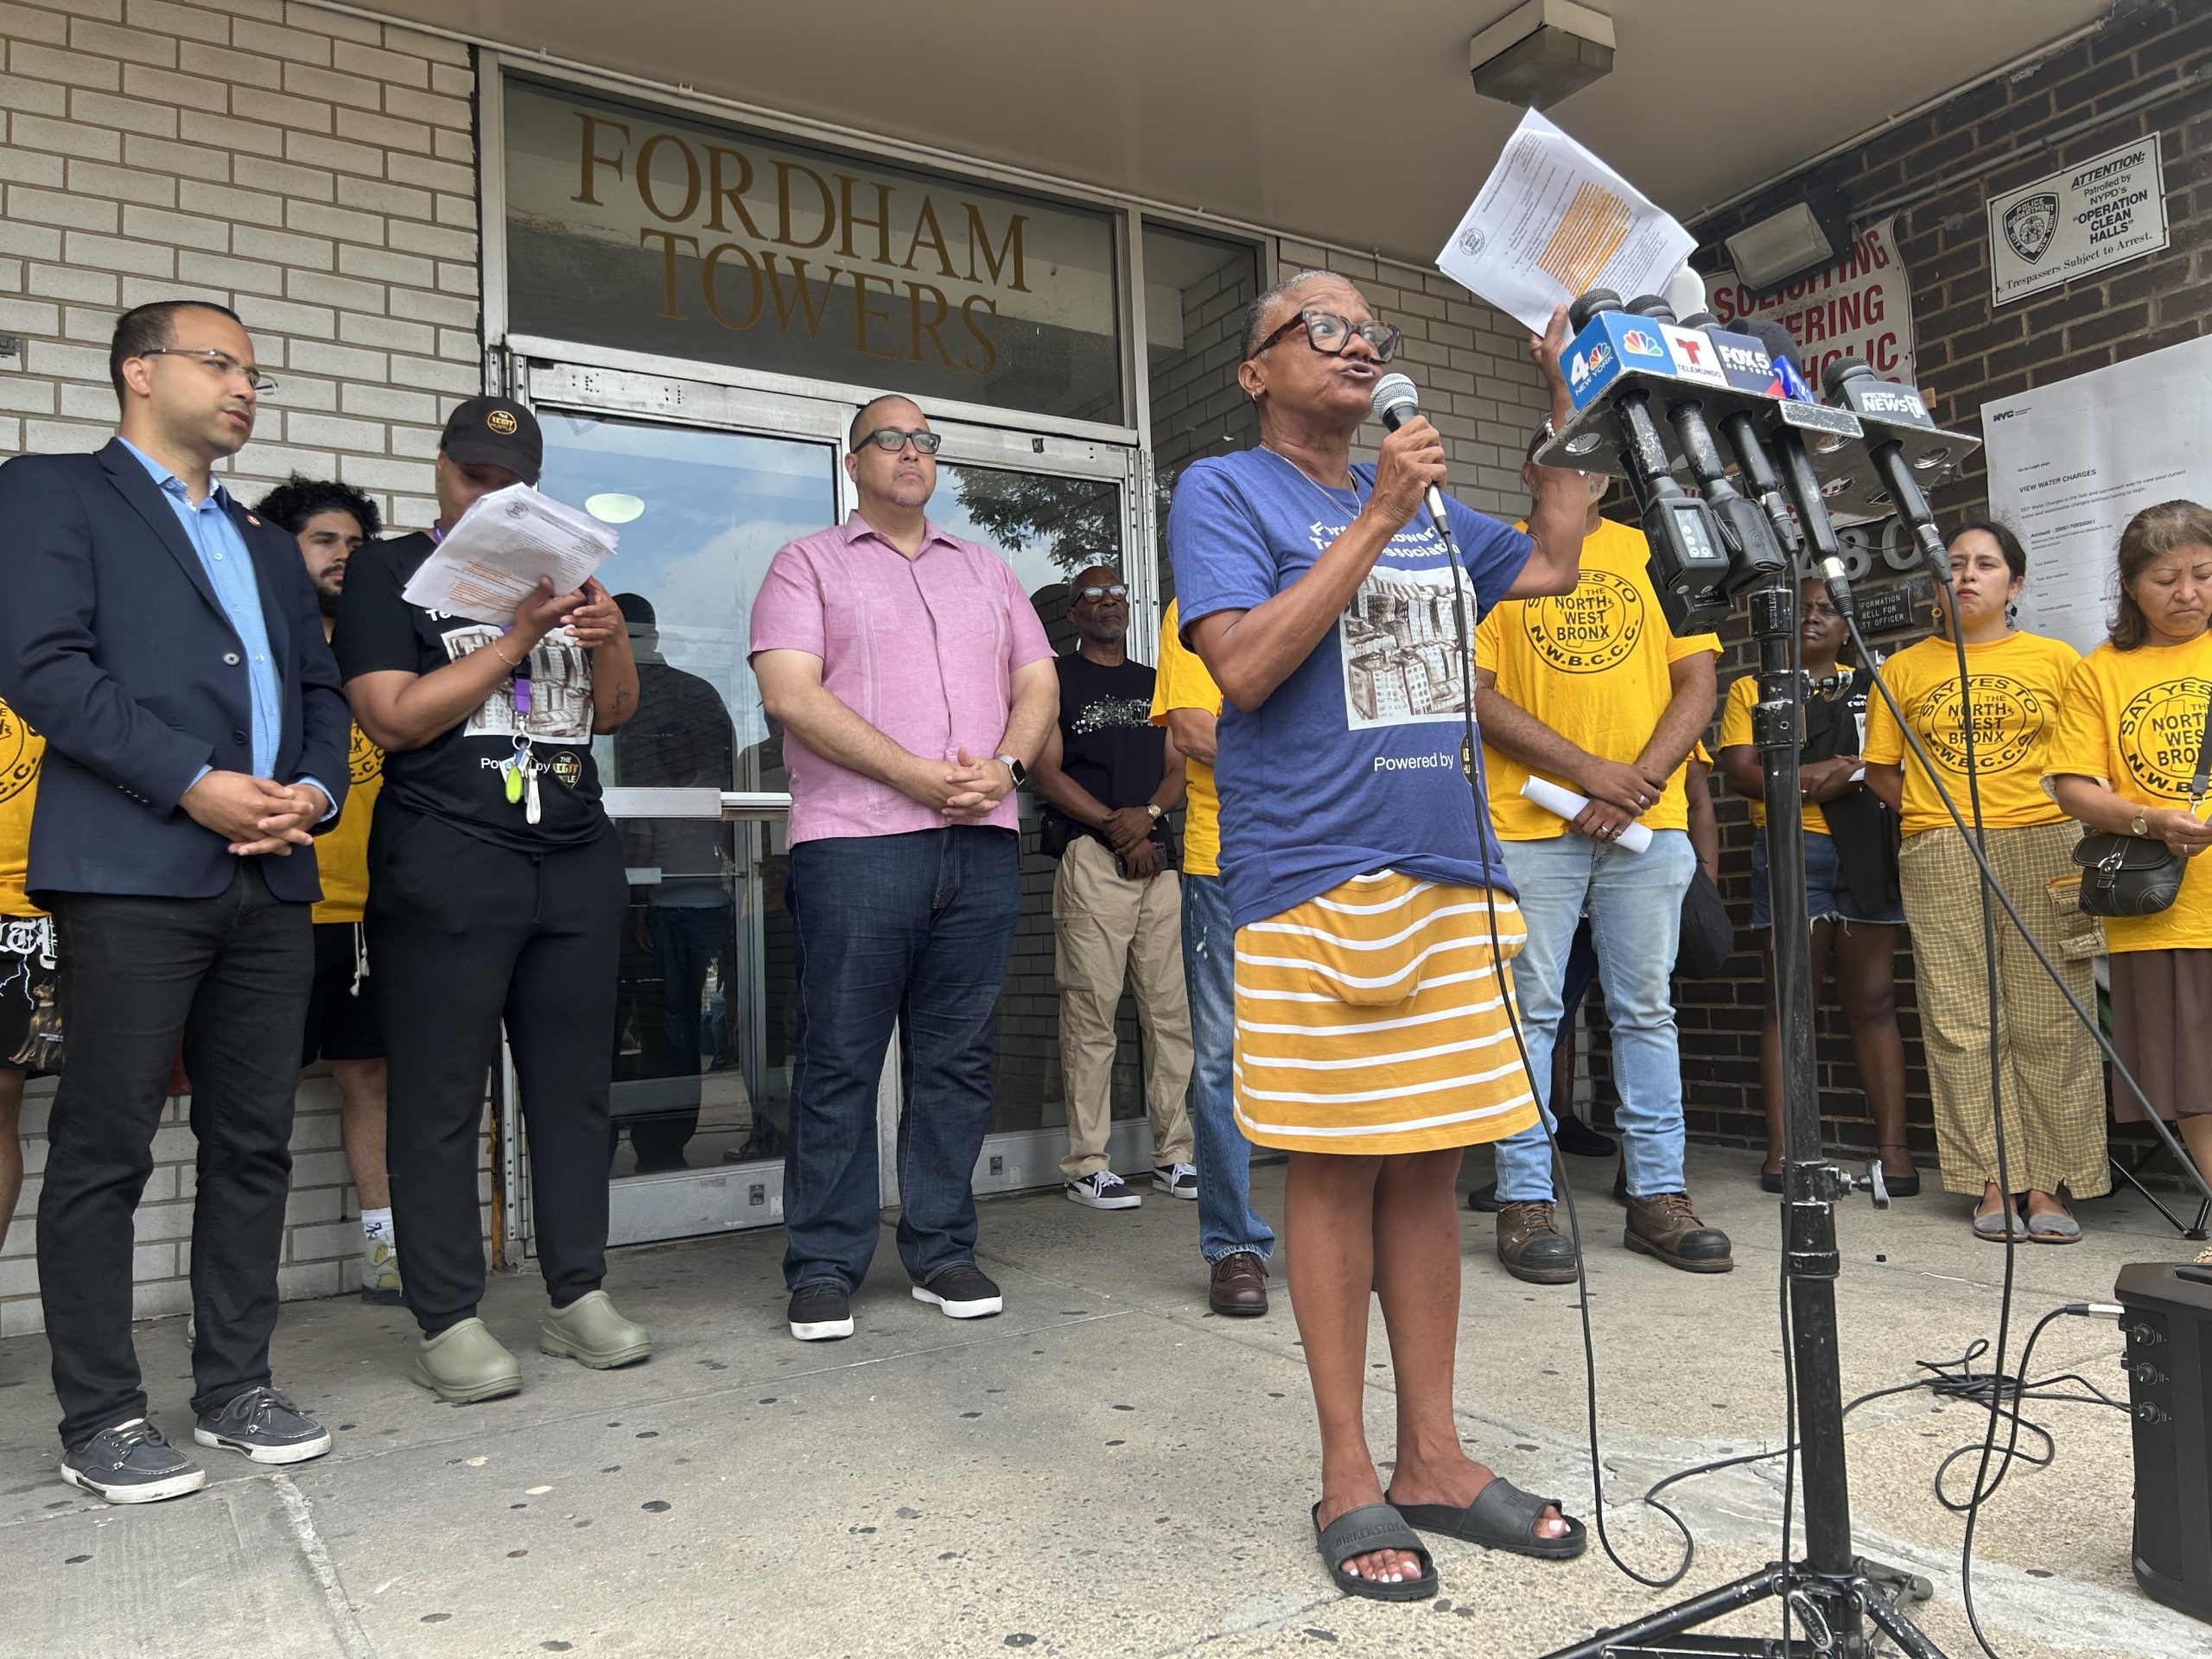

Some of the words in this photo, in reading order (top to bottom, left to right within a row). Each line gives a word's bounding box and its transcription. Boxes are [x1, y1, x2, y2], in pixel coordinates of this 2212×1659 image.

[2070, 150, 2145, 189] ATTENTION:
[2083, 177, 2120, 197] Patrolled
[2120, 173, 2132, 185] by
[2089, 186, 2127, 206] NYPD's
[570, 111, 1033, 294] FORDHAM
[2016, 197, 2044, 214] POLICE
[2007, 204, 2055, 228] DEPARTMENT
[2090, 208, 2132, 232] CLEAN
[2037, 236, 2048, 252] NEW
[2046, 213, 2055, 234] YORK
[2005, 264, 2062, 290] Trespassers
[2063, 251, 2101, 270] Subject
[2103, 244, 2114, 254] to
[2117, 231, 2153, 251] Arrest.
[639, 226, 998, 377] TOWERS
[1571, 351, 1589, 386] 4
[1575, 377, 1592, 397] NEW
[1592, 353, 1614, 378] YORK
[1677, 364, 1722, 378] TELEMUNDO
[1749, 367, 1774, 377] YORK
[1862, 398, 1909, 412] NEWS
[2018, 484, 2037, 493] VIEW
[2037, 477, 2061, 488] WATER
[2062, 468, 2097, 482] CHARGES
[1613, 578, 1637, 603] TO
[1555, 594, 1607, 610] NORTH
[1862, 610, 1879, 620] BELL
[1883, 605, 1897, 614] FOR
[1565, 610, 1605, 625] WEST
[1874, 613, 1904, 626] OFFICER
[1557, 625, 1610, 641] BRONX
[1923, 682, 1955, 718] SAY
[2015, 687, 2037, 714] TO
[2122, 693, 2152, 735] SAY
[2152, 712, 2206, 732] NORT
[2164, 728, 2203, 747] WES
[1374, 752, 1438, 772] Powered
[1440, 752, 1453, 769] by
[2157, 747, 2200, 767] BRO
